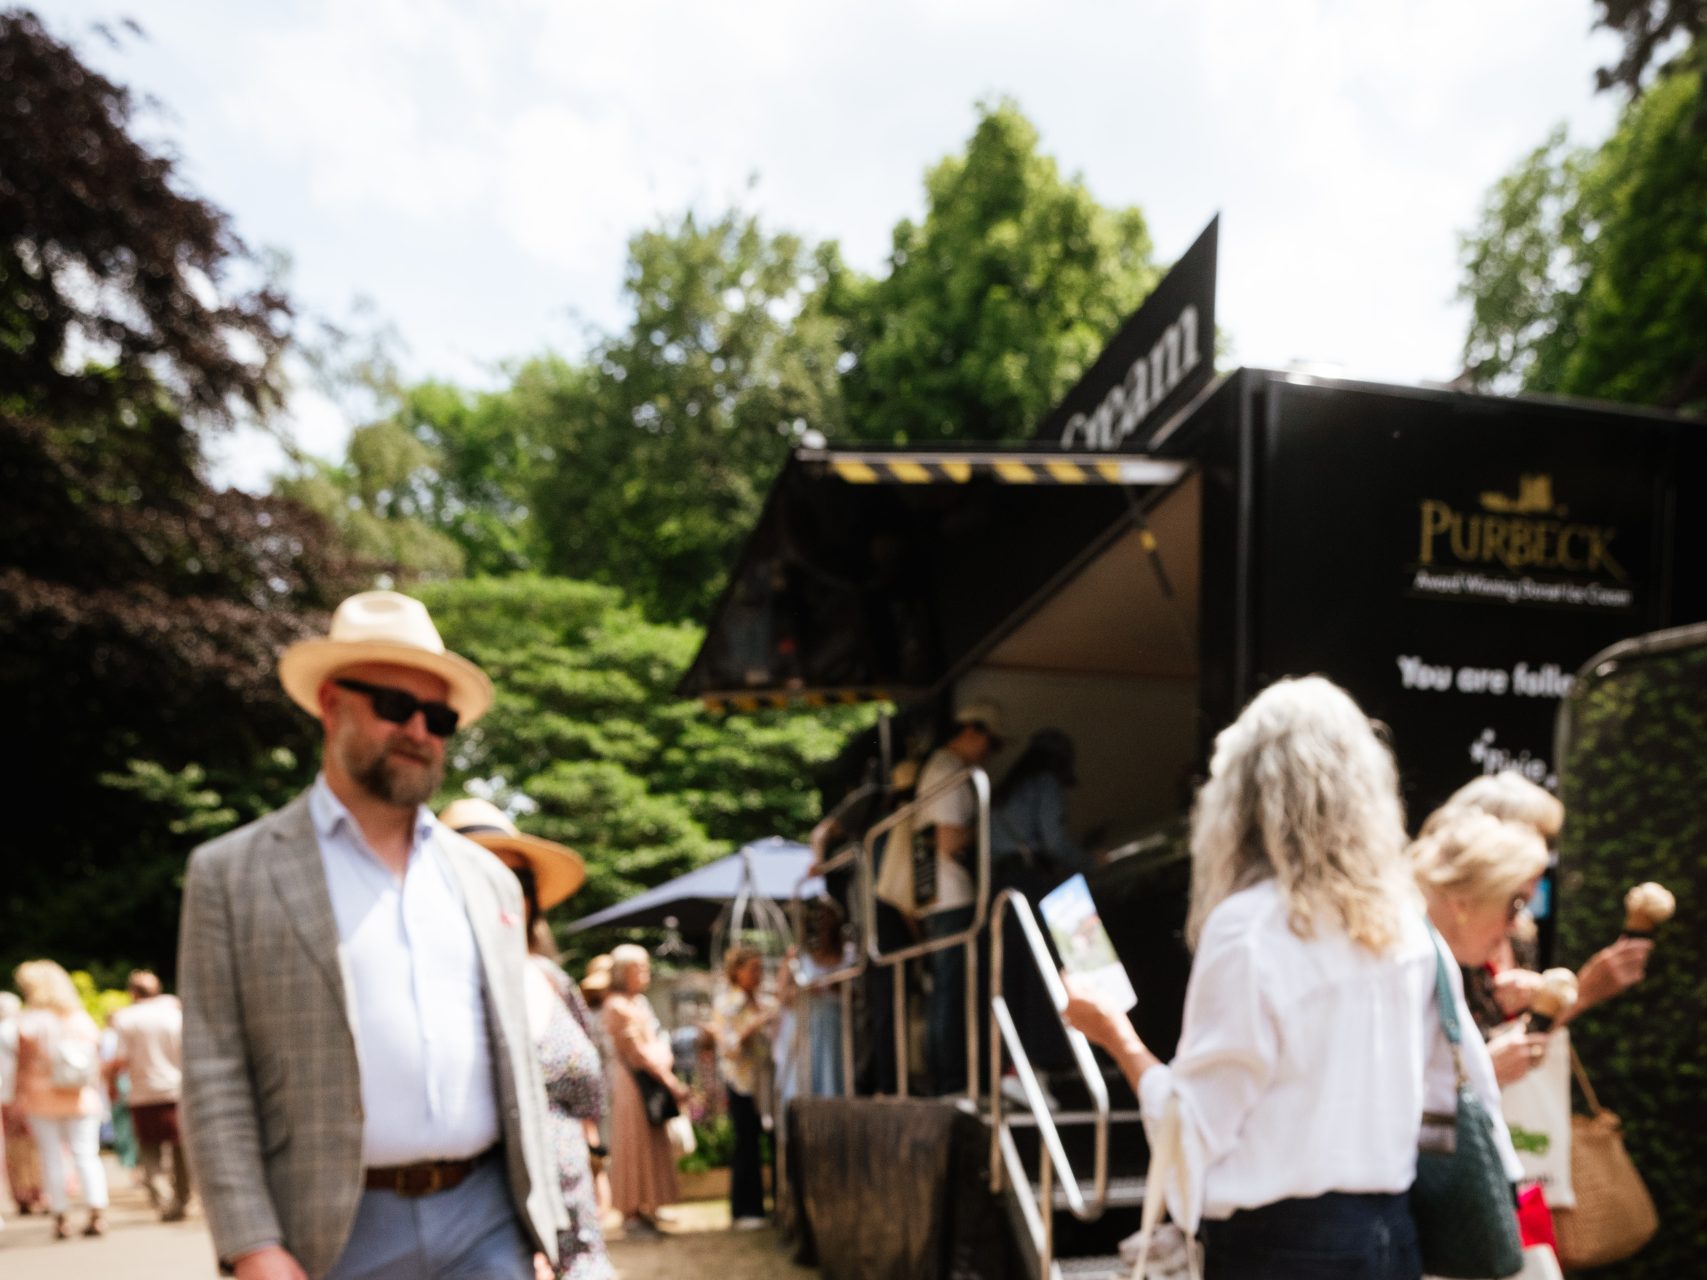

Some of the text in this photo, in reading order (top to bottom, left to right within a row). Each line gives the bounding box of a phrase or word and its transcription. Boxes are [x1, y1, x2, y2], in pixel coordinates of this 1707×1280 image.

[1420, 498, 1628, 580] PURBECK
[1397, 655, 1453, 692] You
[1456, 666, 1509, 696] are
